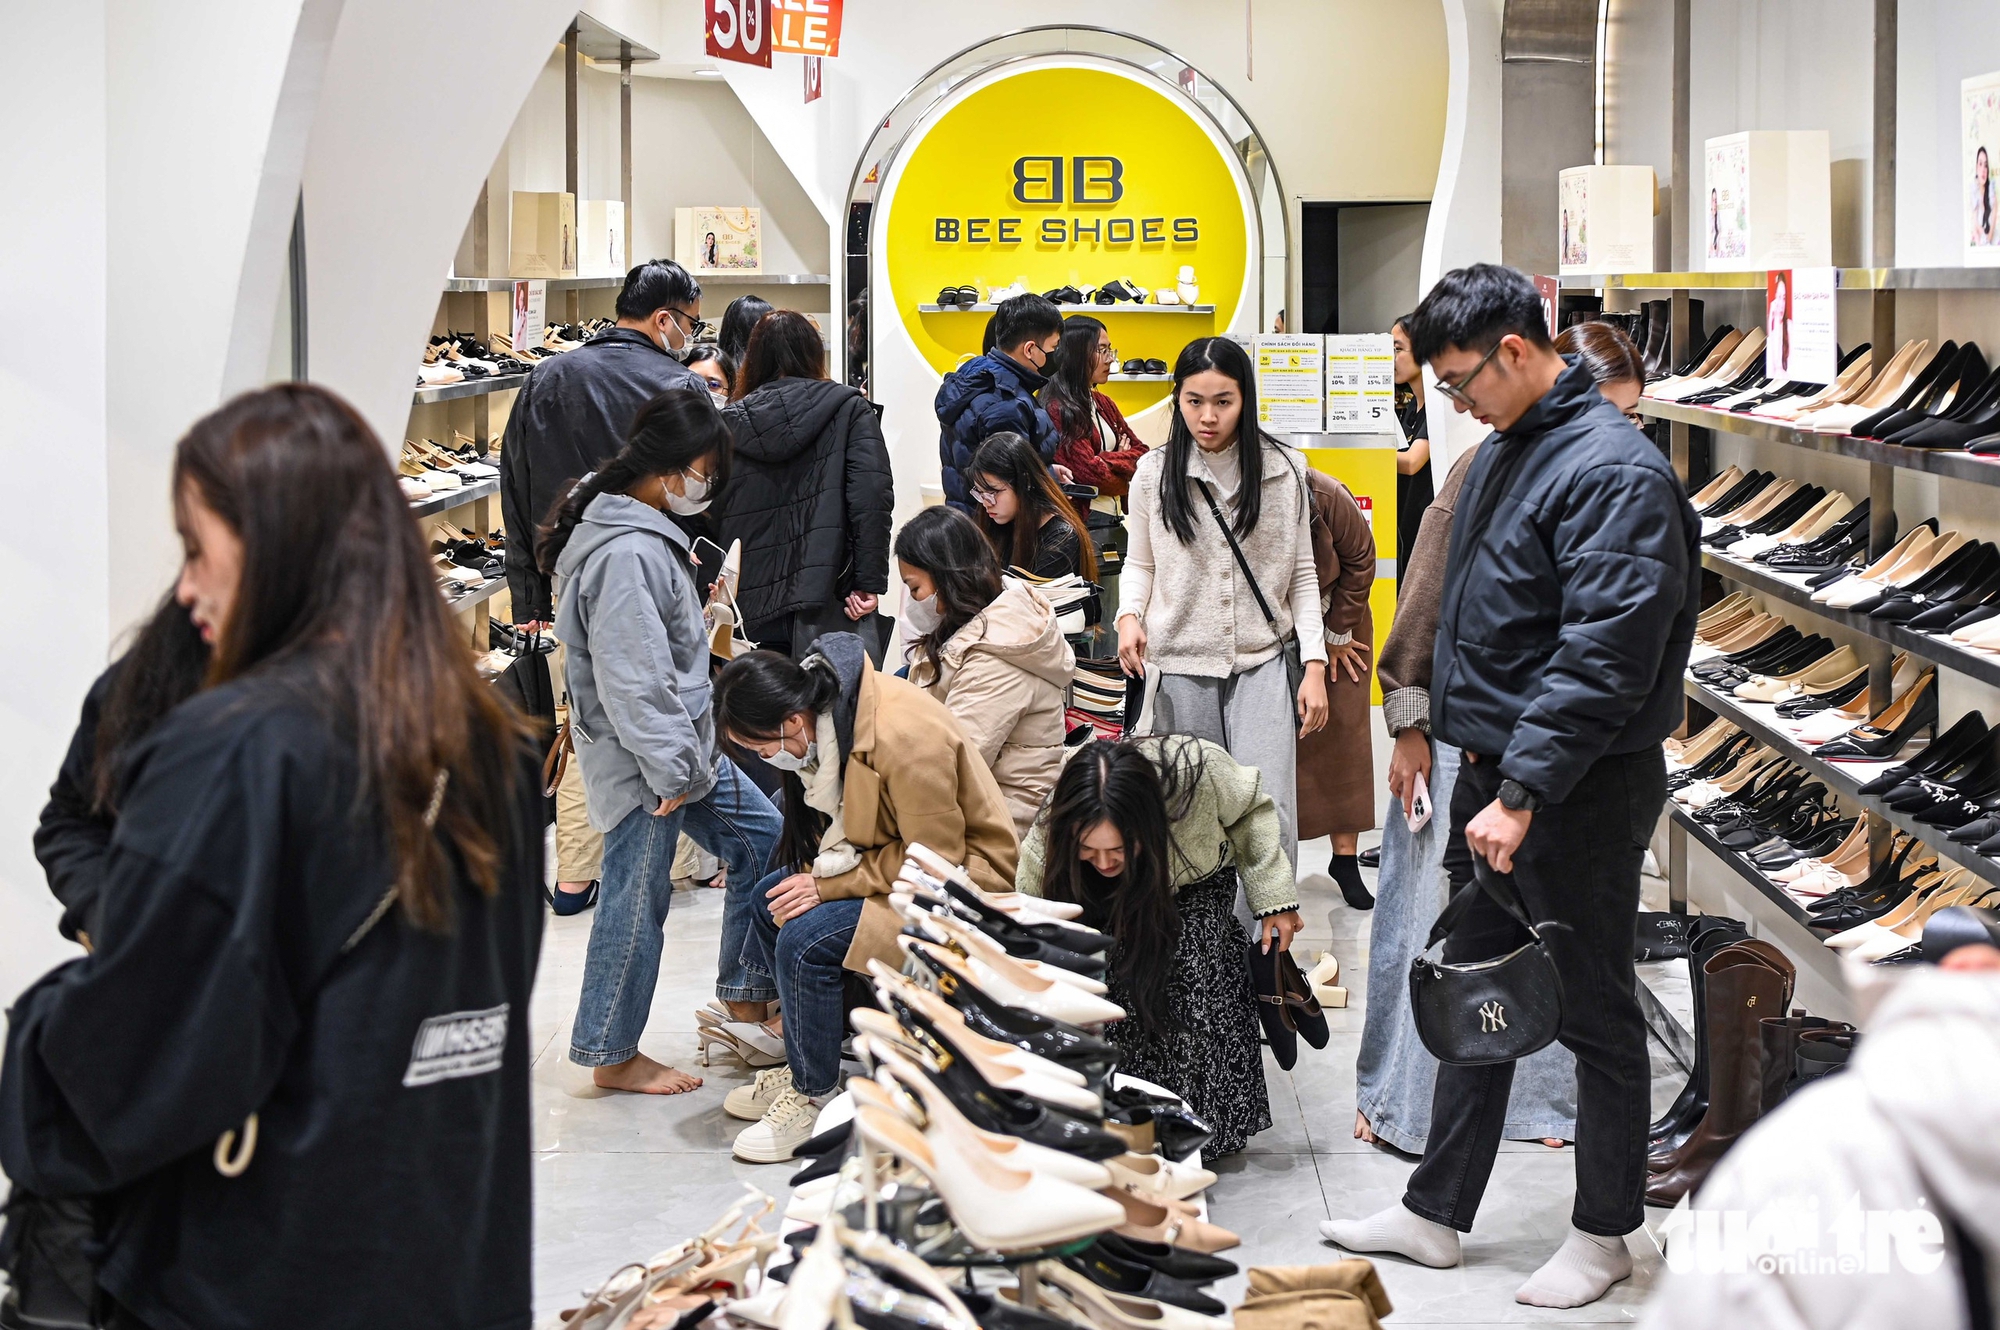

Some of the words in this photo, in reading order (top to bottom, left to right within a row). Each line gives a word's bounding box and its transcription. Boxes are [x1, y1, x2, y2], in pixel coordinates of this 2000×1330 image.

[771, 13, 828, 50] LE
[1041, 217, 1199, 243] SHOES
[1478, 1001, 1508, 1033] NY
